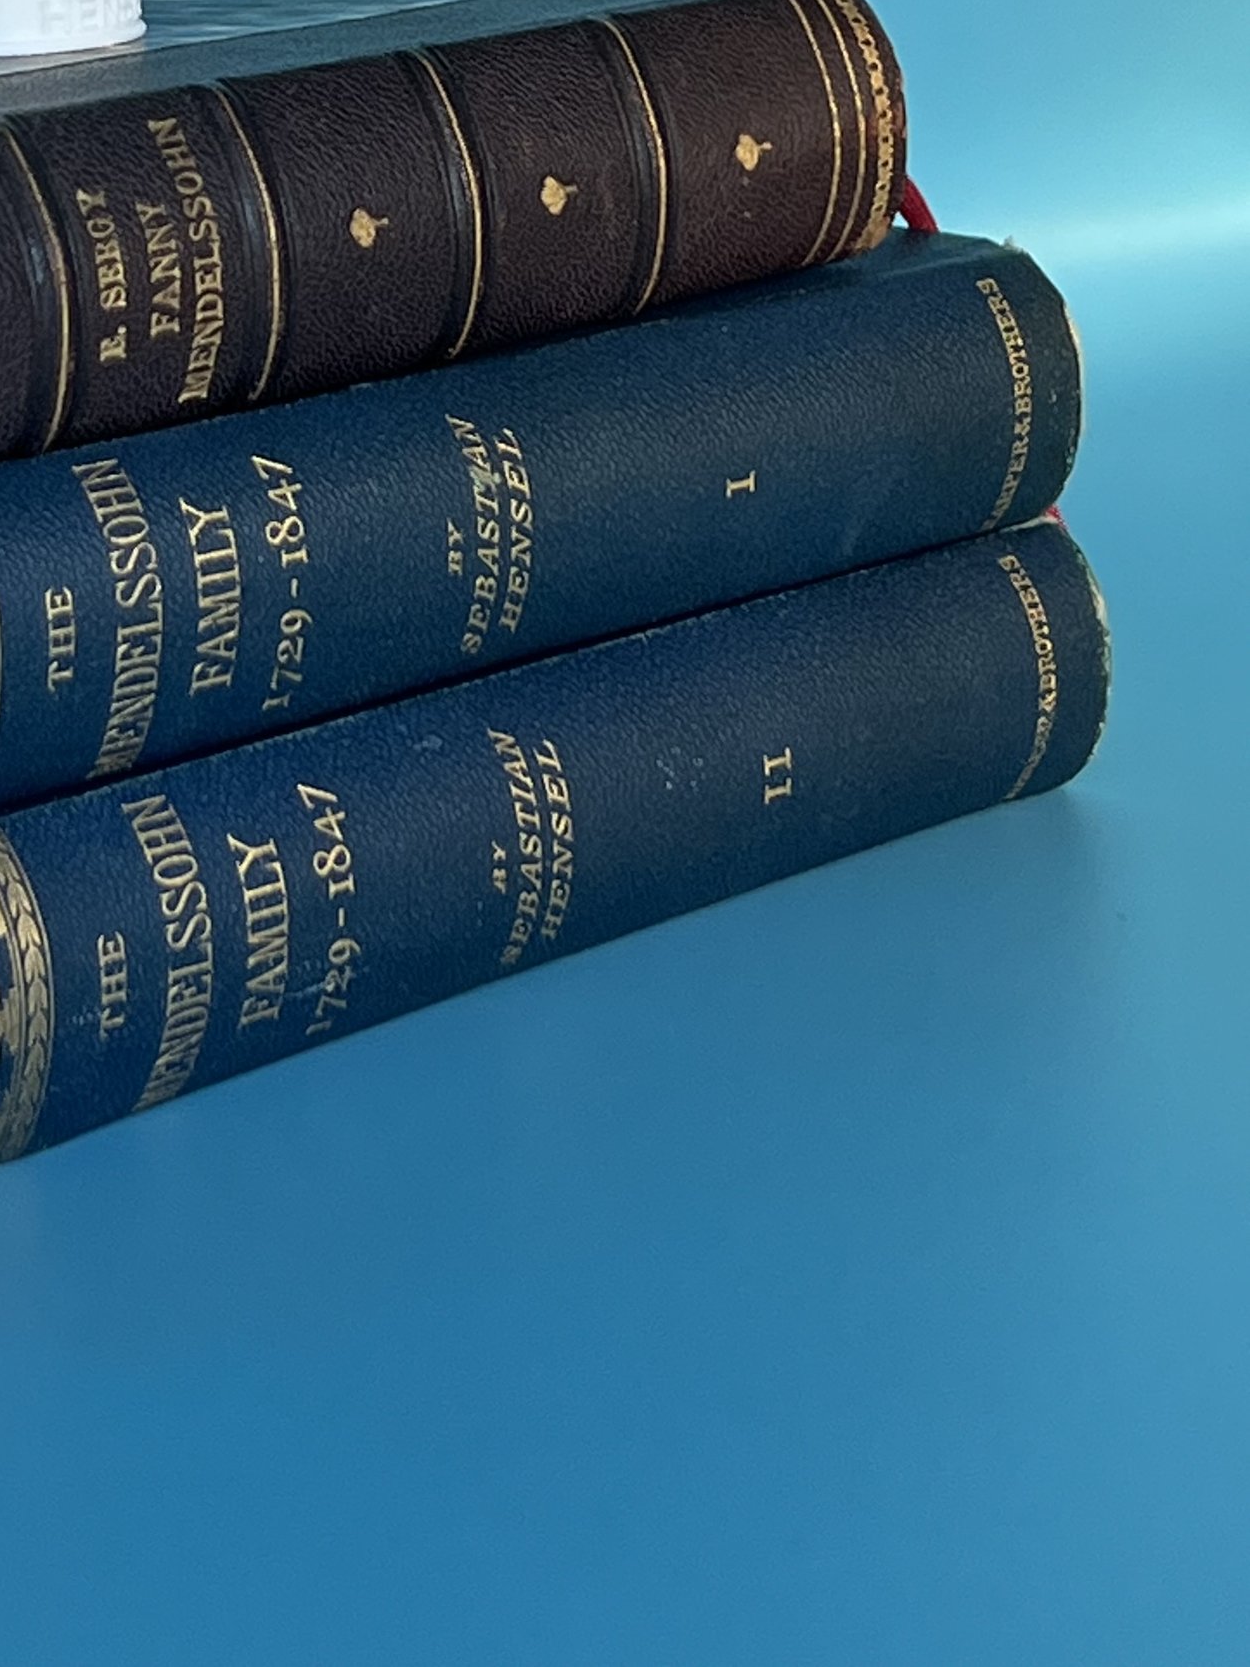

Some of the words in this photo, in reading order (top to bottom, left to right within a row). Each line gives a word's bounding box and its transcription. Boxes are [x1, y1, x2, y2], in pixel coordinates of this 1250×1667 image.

[76, 188, 127, 312] SERGY
[136, 202, 182, 337] FANNY
[148, 117, 224, 404] MENDELSSOHN
[976, 278, 1033, 416] BROTHERS
[178, 496, 242, 698] FAMILY
[445, 413, 500, 654] SEBASTIAN
[446, 517, 464, 576] BY
[495, 427, 533, 633] HENSEL
[45, 586, 76, 692] THE
[71, 458, 164, 780] MENDELSSOHN
[997, 554, 1057, 692] BROTHERS
[486, 726, 544, 966] SEBASTIAN
[532, 738, 575, 939] HENSEL
[762, 746, 793, 805] II
[227, 832, 290, 1028] FAMILY
[490, 840, 508, 894] BY
[96, 931, 127, 1041] THE
[121, 794, 214, 1113] MENDELSSOHN
